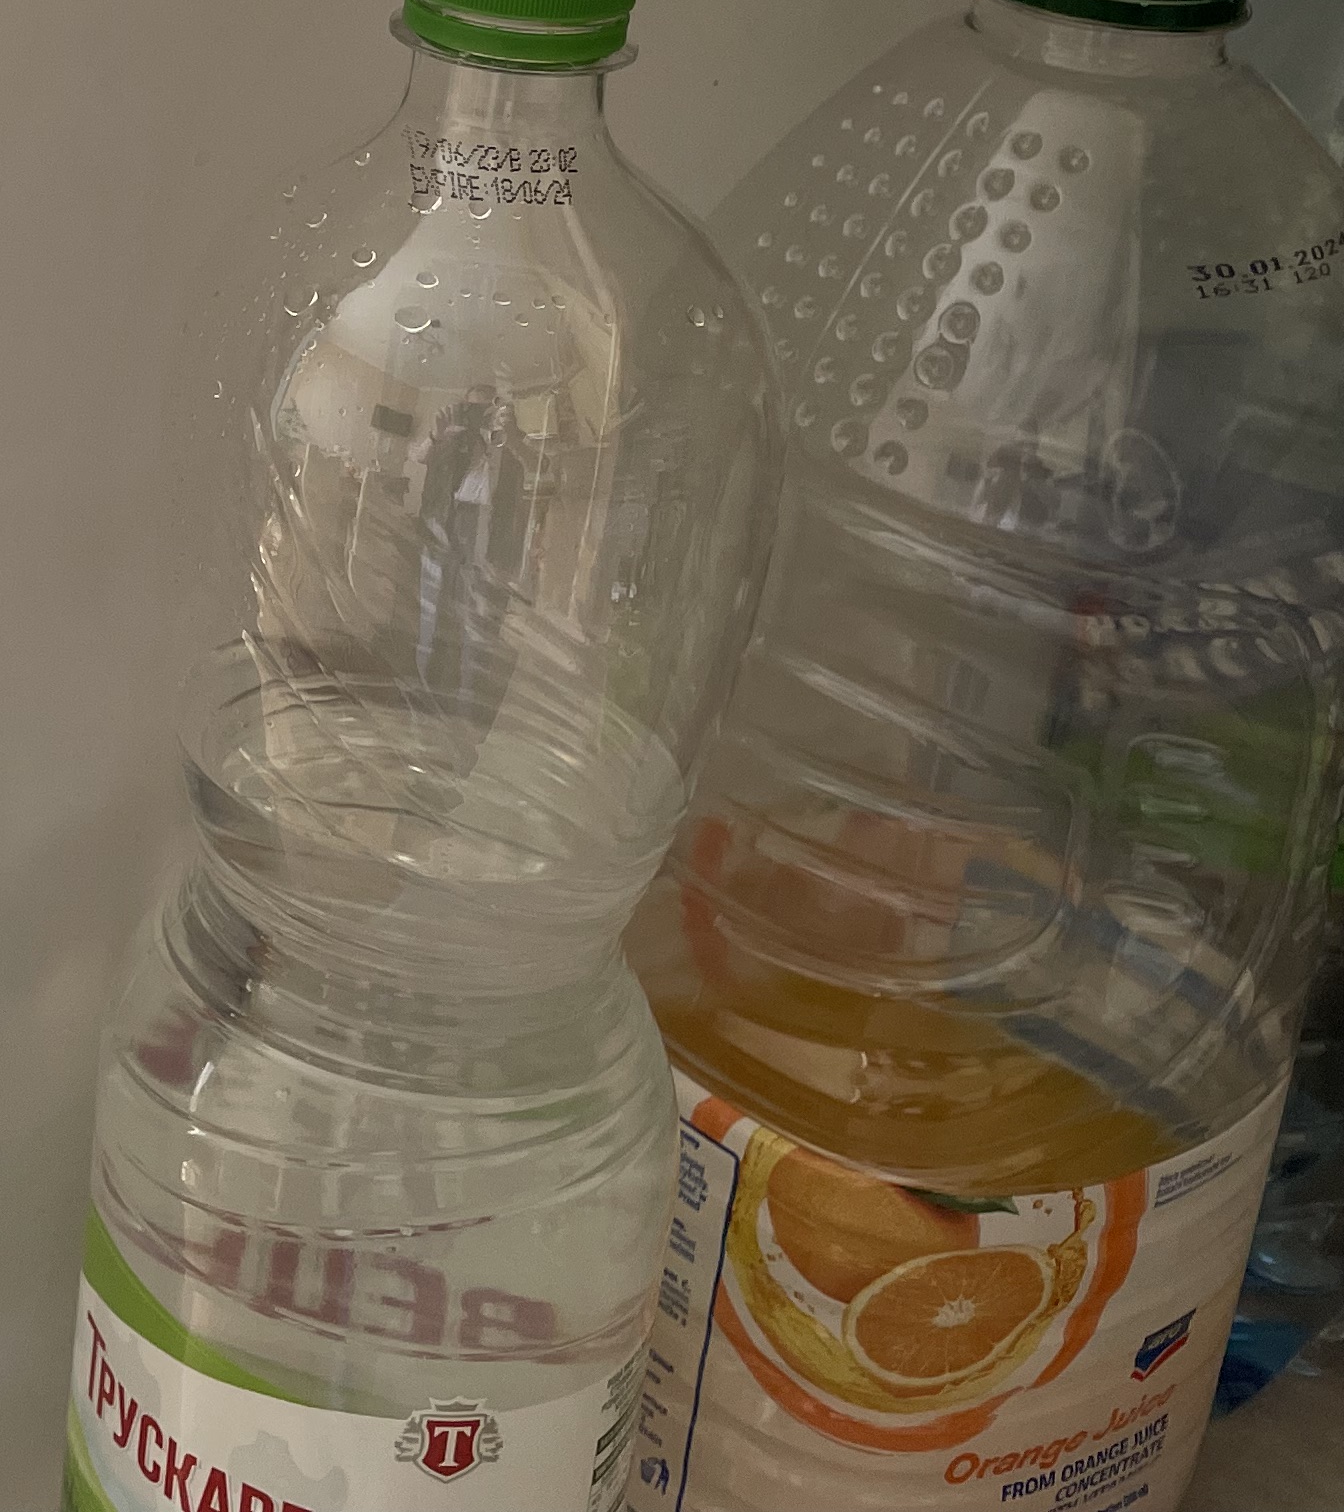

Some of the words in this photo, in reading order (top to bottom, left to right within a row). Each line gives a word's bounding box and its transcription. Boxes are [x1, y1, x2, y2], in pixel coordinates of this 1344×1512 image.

[529, 147, 579, 173] 23:02
[1292, 262, 1331, 284] 120
[86, 1310, 313, 1512] ТРУСКА
[944, 1430, 1088, 1485] Orange
[1092, 1384, 1177, 1441] Juice
[1001, 1470, 1055, 1502] FROM
[1061, 1438, 1128, 1481] ORANGE
[1131, 1413, 1170, 1452] JUICE
[1054, 1438, 1167, 1502] CONCENTRATE
